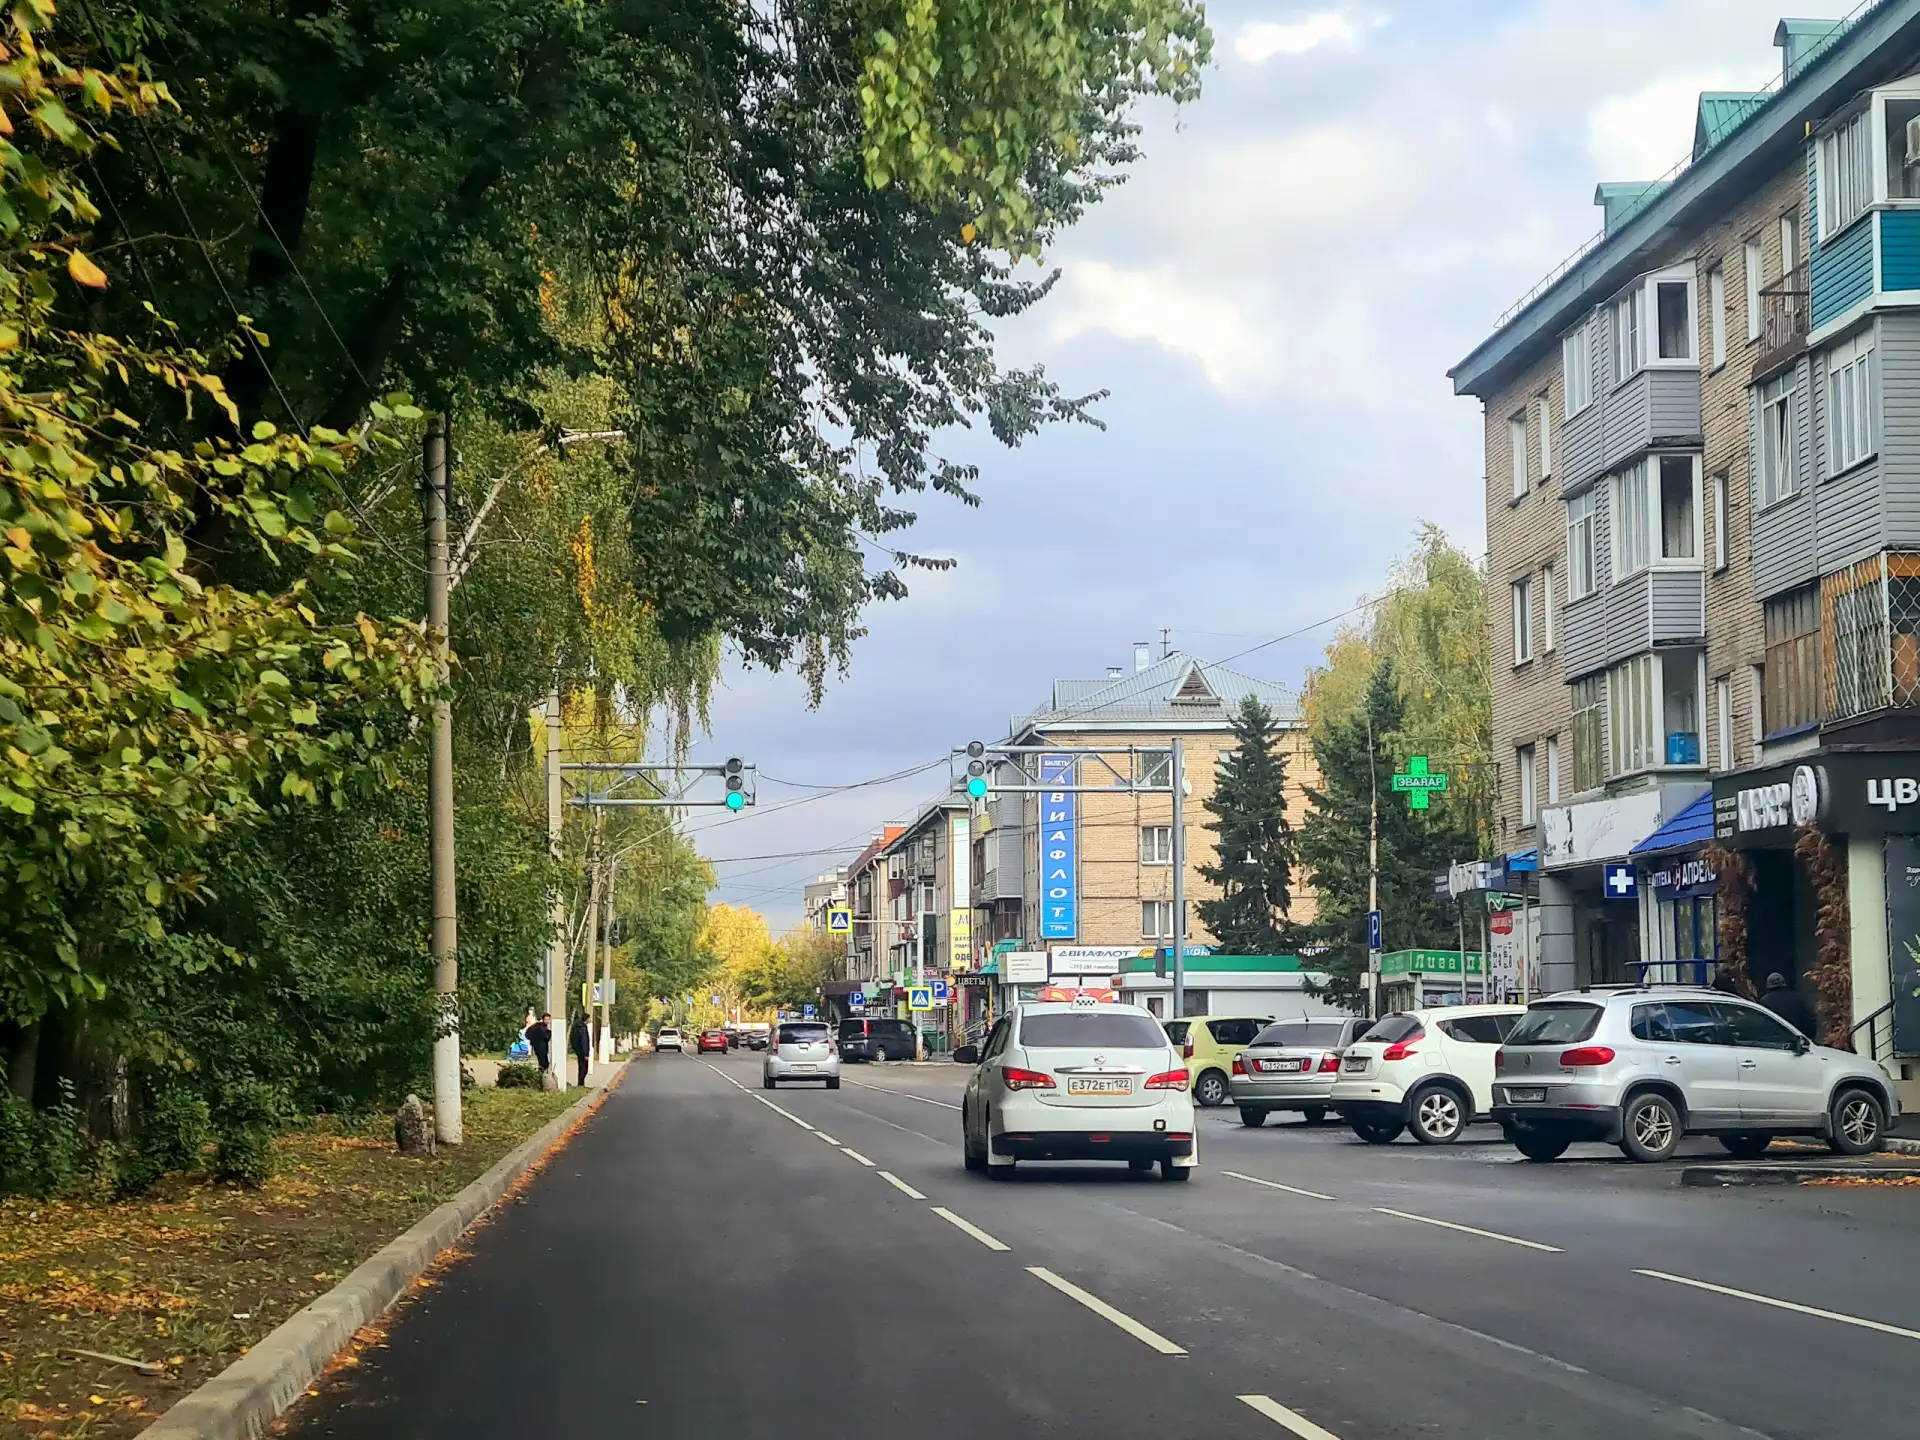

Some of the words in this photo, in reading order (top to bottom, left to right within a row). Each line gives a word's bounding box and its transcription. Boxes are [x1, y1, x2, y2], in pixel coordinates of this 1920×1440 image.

[1867, 778, 1920, 812] ЦВ
[1651, 869, 1672, 888] АПТЕКА
[1371, 915, 1379, 945] P
[1058, 950, 1132, 958] АВИАФЛОТ
[957, 977, 986, 986] ЦВЕТЫ
[934, 981, 944, 996] P
[854, 993, 862, 1004] P
[1114, 1079, 1129, 1088] 122
